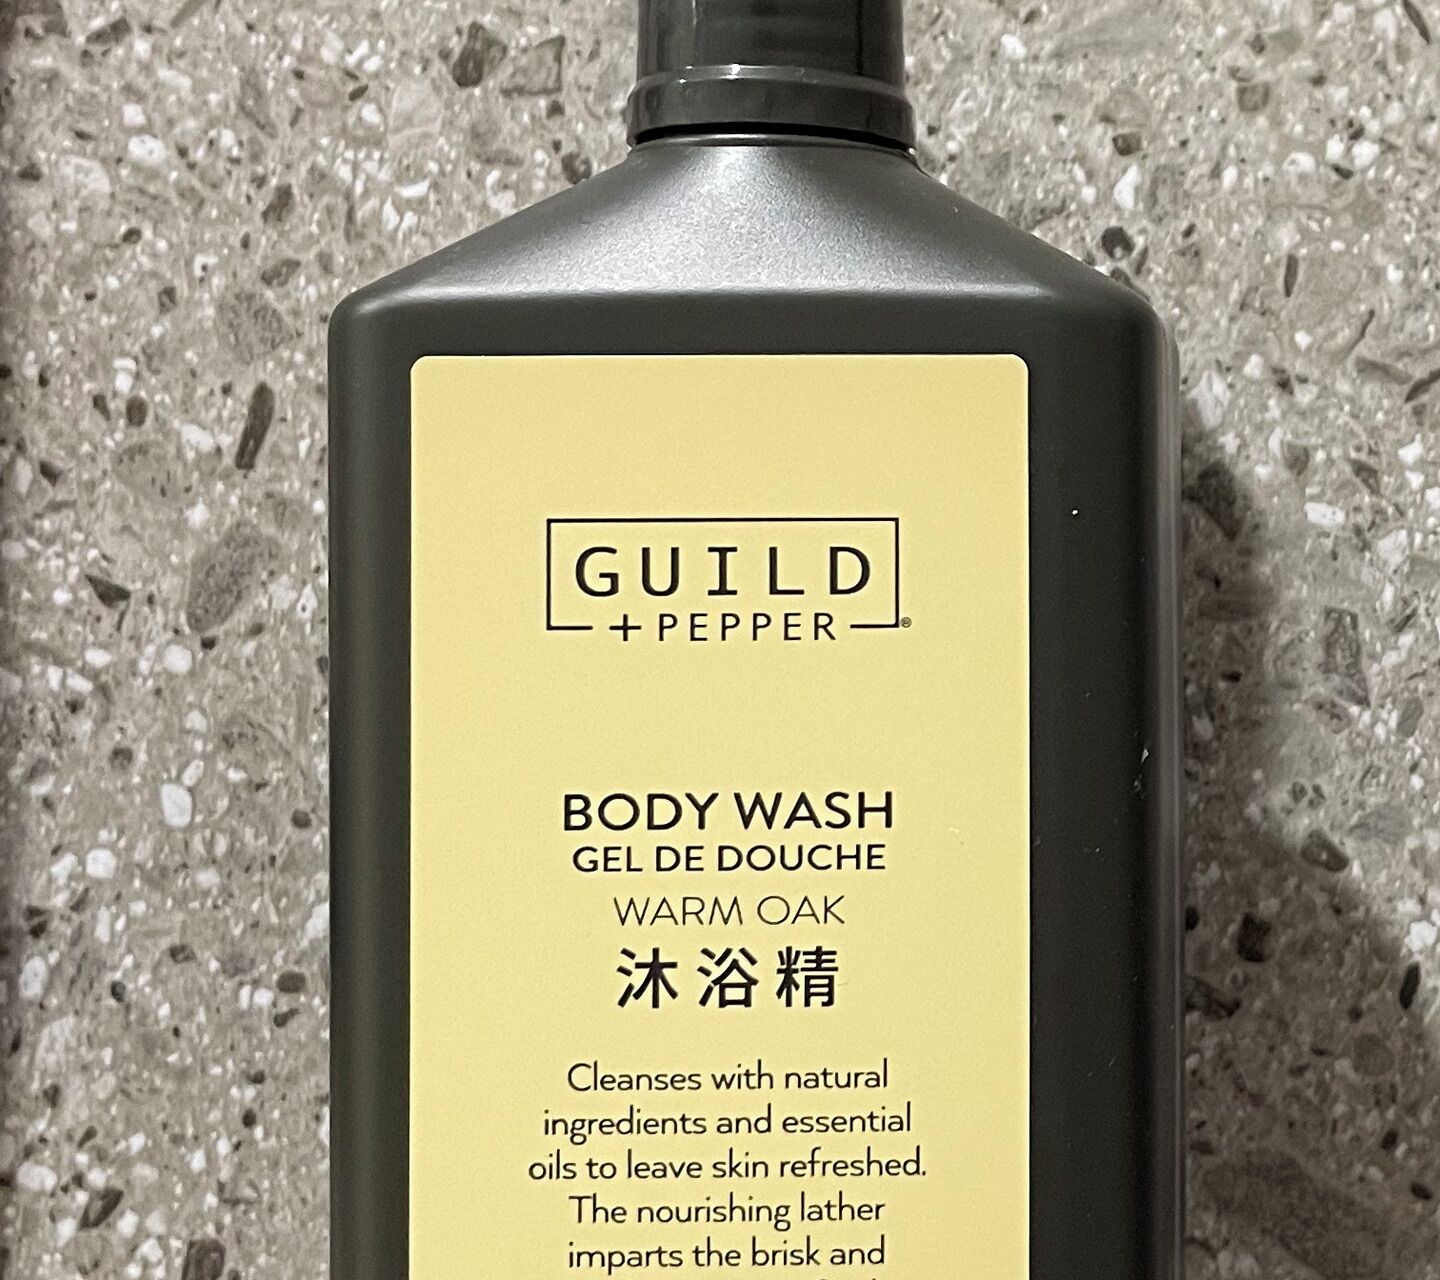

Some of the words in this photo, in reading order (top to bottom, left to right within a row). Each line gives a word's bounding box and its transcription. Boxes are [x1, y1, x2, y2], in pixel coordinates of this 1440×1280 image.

[575, 546, 871, 598] GUILD
[563, 792, 720, 832] BODY
[733, 790, 893, 831] WASH
[572, 845, 644, 873] GEL
[655, 845, 705, 873] DE
[717, 843, 886, 872] DOUCHE
[613, 895, 744, 927] WARM
[756, 895, 845, 926] OAK
[616, 945, 839, 1009] 沐浴精
[567, 1060, 702, 1092] Cleanses
[710, 1058, 774, 1090] with
[784, 1057, 888, 1090] natural
[544, 1104, 708, 1146] ingredients
[716, 1102, 772, 1135] and
[781, 1100, 912, 1134] essential
[528, 1148, 578, 1181] oils
[585, 1157, 617, 1180] to
[627, 1148, 703, 1180] leave
[712, 1146, 769, 1179] skin
[779, 1144, 927, 1178] refreshed.
[568, 1192, 628, 1224] The
[637, 1191, 791, 1232] nourishing
[800, 1189, 886, 1222] lather
[568, 1241, 684, 1276] imparts
[691, 1235, 742, 1268] the
[751, 1234, 821, 1267] brisk
[829, 1233, 885, 1266] and
